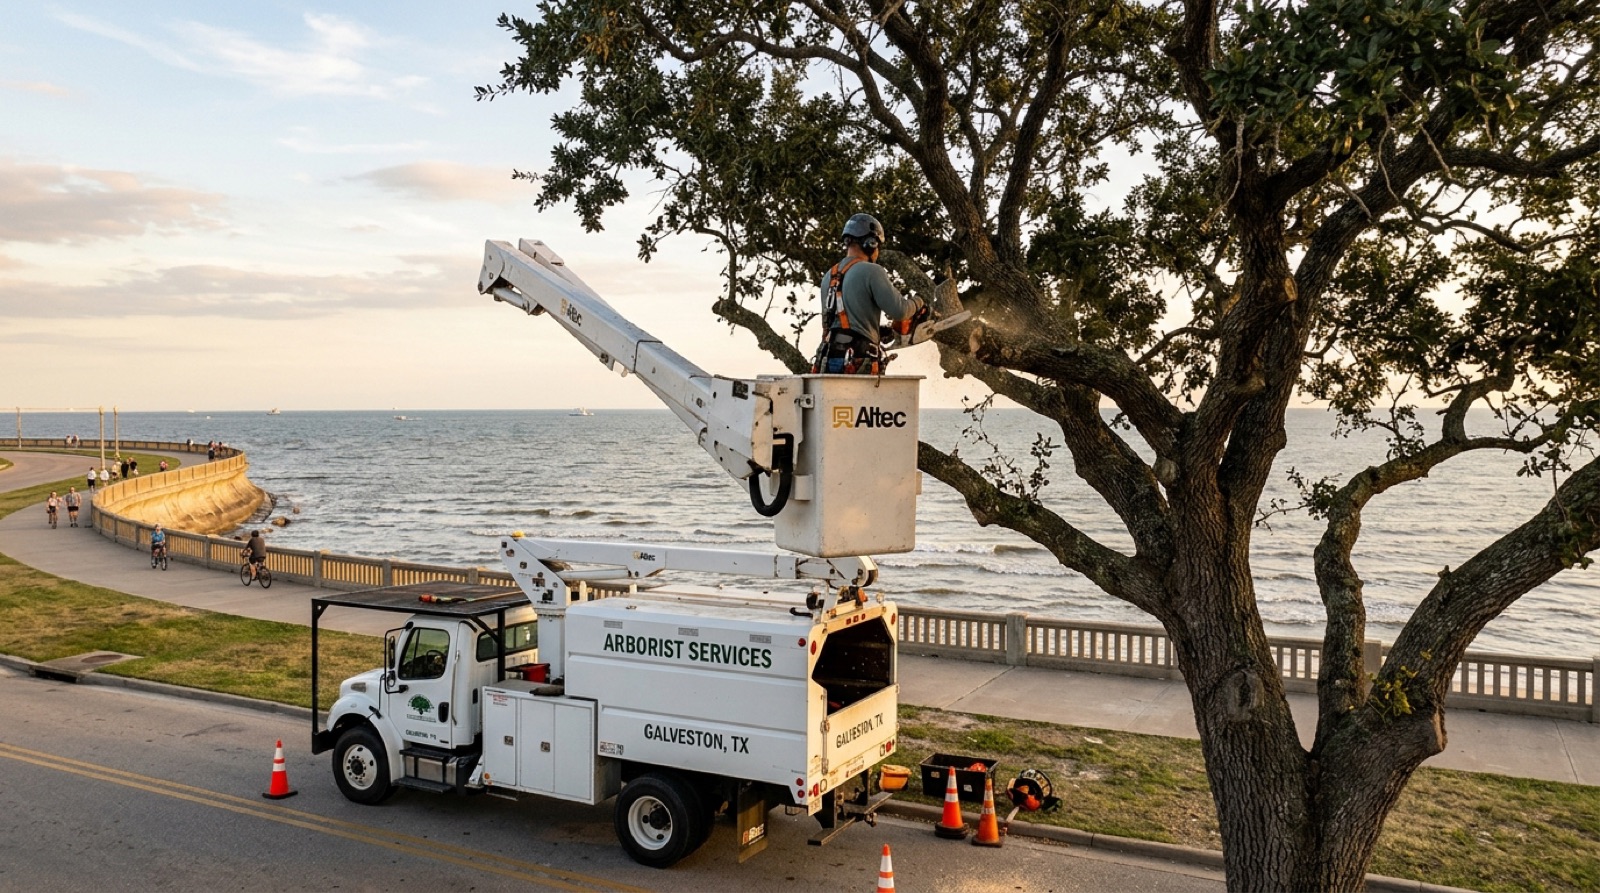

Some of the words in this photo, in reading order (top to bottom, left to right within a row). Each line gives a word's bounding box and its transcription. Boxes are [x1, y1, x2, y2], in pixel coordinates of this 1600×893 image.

[855, 406, 907, 428] Altec
[603, 633, 684, 659] ARBORIST
[688, 641, 772, 668] SERVICES
[644, 723, 727, 753] GALVESTON,
[731, 735, 750, 754] TX
